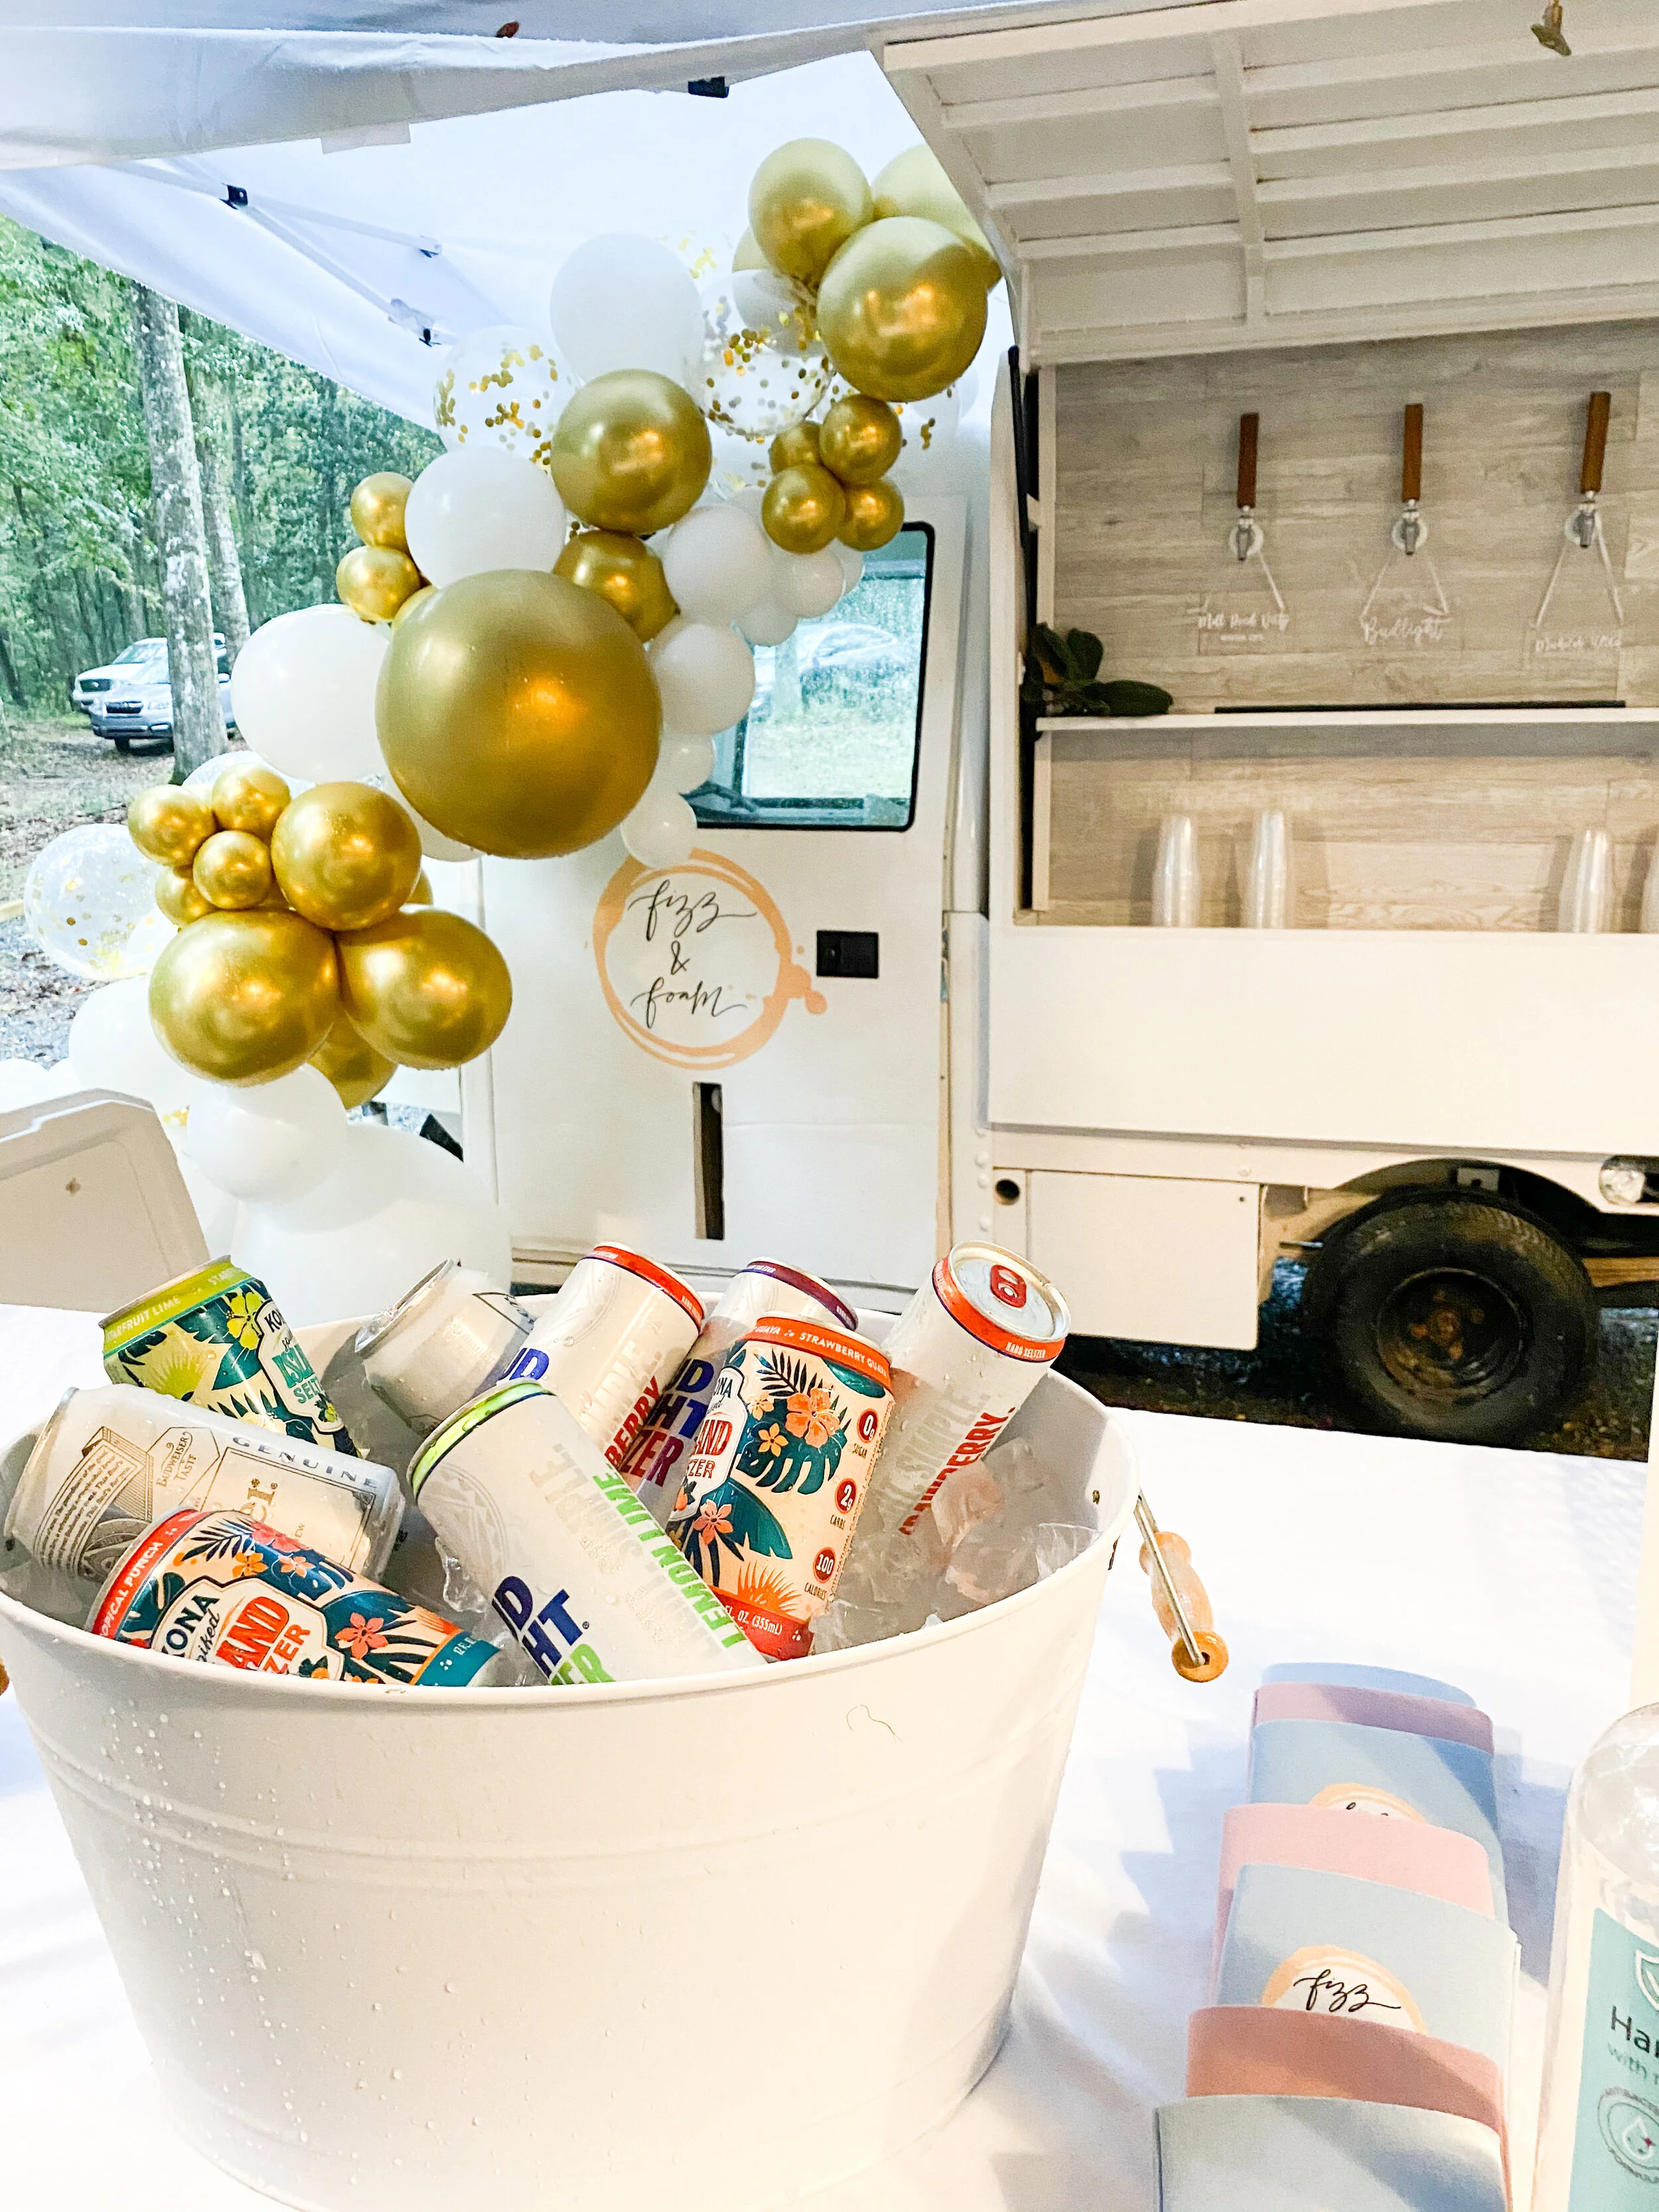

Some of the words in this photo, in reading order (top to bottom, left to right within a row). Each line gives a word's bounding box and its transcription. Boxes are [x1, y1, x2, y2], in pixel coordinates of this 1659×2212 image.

[628, 879, 757, 941] fizz
[670, 940, 691, 975] &
[630, 977, 748, 1029] foam
[152, 1295, 181, 1317] LIME
[799, 1332, 865, 1364] STRAWBERRY
[1005, 1341, 1023, 1357] HARD
[1023, 1347, 1046, 1359] SELTZER
[863, 1414, 875, 1441] 0g
[232, 1436, 378, 1489] GENUINE
[853, 1442, 868, 1459] SUGAR
[173, 1453, 197, 1481] TASTE
[840, 1484, 853, 1511] 2g
[830, 1514, 846, 1530] CARBS
[816, 1554, 834, 1575] 100
[101, 1589, 129, 1637] OPICAL
[123, 1542, 164, 1587] PUNCH
[651, 1544, 748, 1649] LEMON
[804, 1582, 828, 1600] CALORIES
[737, 1609, 749, 1625] OZ.
[752, 1615, 783, 1636] (355mL)
[1293, 1968, 1402, 2012] fizz
